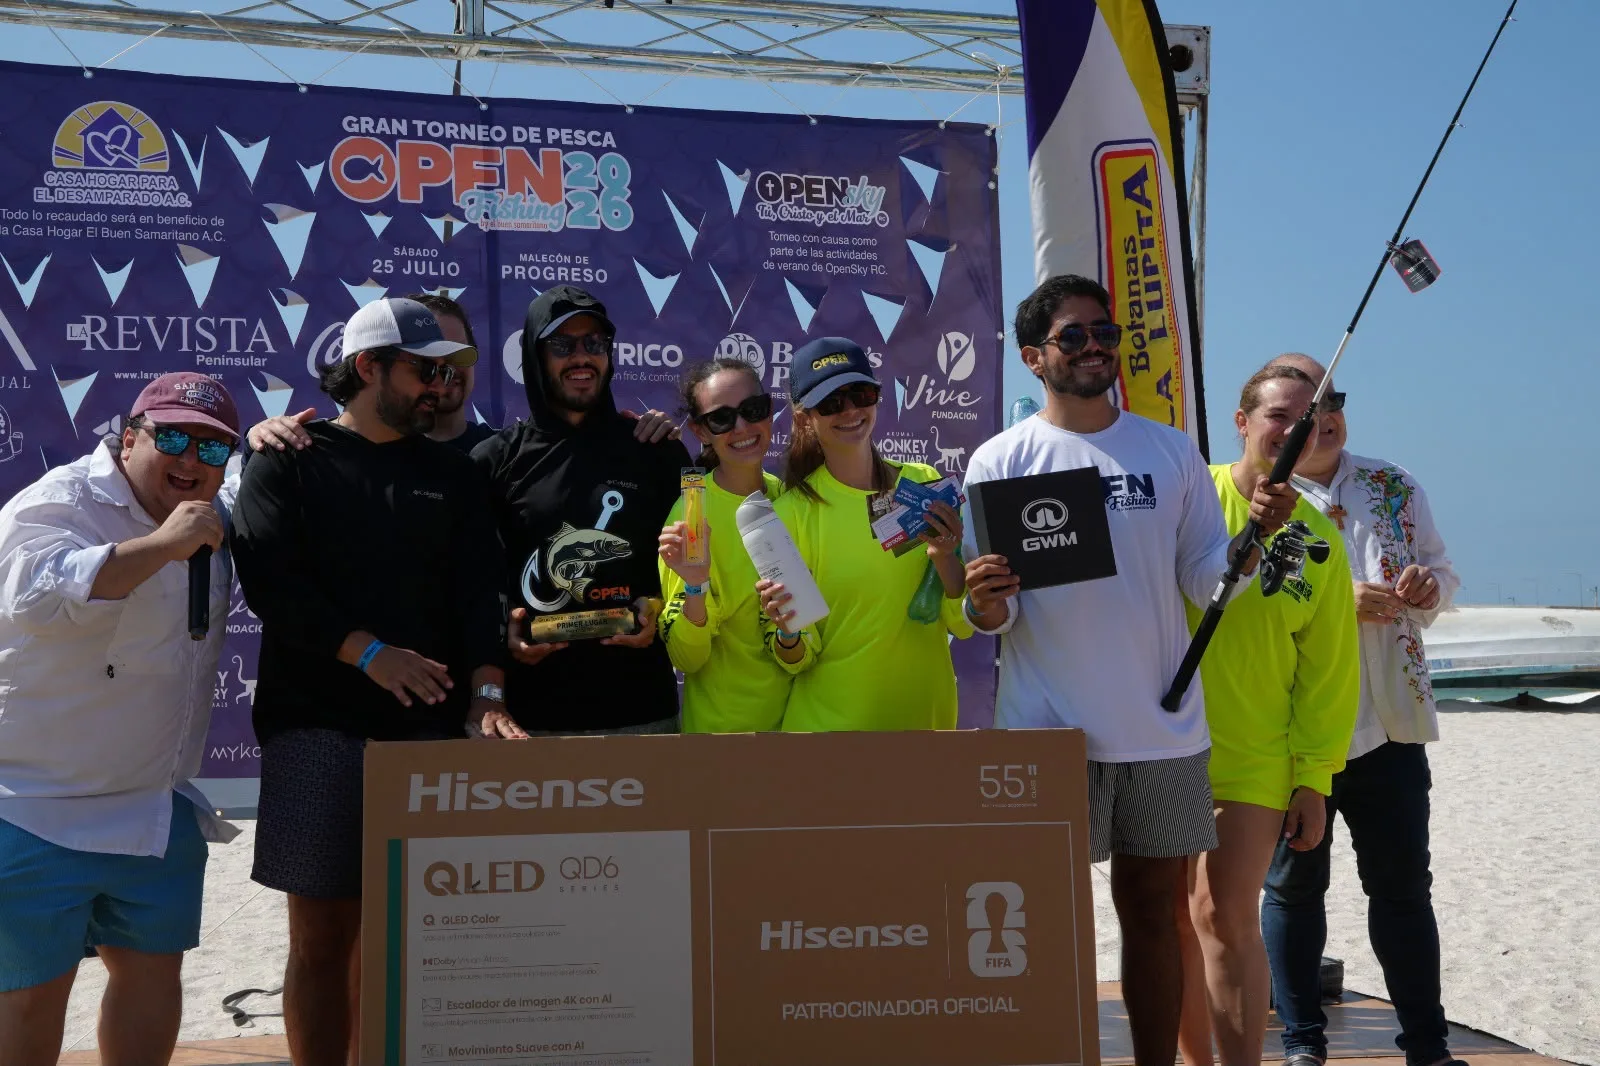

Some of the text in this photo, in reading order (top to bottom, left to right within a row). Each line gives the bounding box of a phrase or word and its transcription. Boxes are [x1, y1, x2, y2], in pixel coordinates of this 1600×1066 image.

[341, 115, 617, 148] GRAN TORNEO DE PESCA
[329, 136, 566, 205] OPEN
[44, 171, 179, 191] CASA HOGAR PARA
[33, 187, 192, 208] EL DESAMPARADO A.C.
[2, 208, 225, 227] Todo lo recaudado será en beneficio de
[460, 189, 567, 231] Fishing
[778, 205, 814, 222] Cristo
[815, 211, 824, 226] y
[826, 208, 839, 223] el
[840, 208, 870, 225] Mar
[0, 225, 226, 242] la Casa Hogar El Buen Samaritano A.C.
[768, 231, 877, 246] Torneo con causa como
[393, 246, 438, 257] SÁBADO
[519, 252, 589, 264] MALECÓN DE
[770, 247, 877, 260] parte de las actividades
[1122, 162, 1168, 342] LUPITA
[372, 259, 460, 276] 25 JULIO
[501, 265, 608, 283] PROGRESO
[763, 260, 888, 277] de verano de OpenSky RC.
[1124, 234, 1150, 377] Botanas
[69, 325, 88, 338] LA
[81, 315, 278, 353] REVISTA
[196, 354, 267, 367] Peninsular
[812, 353, 850, 371] OPEN
[639, 371, 647, 381] &
[649, 372, 680, 382] confort
[174, 382, 224, 402] SAN DIEGO
[904, 374, 981, 410] Vive
[180, 396, 218, 411] CALIFORNIA
[931, 410, 978, 420] FUNDACIÓN
[873, 440, 928, 454] MONKEY
[1100, 474, 1155, 497] EN
[1106, 493, 1157, 510] Fishing
[1022, 531, 1078, 552] GWM
[590, 585, 631, 600] OPEN
[556, 618, 608, 630] PRIMER LUGAR
[408, 772, 644, 812] Hisense
[424, 855, 619, 896] QLED QD6
[559, 884, 619, 893] SERIES
[441, 915, 469, 926] QLED
[470, 914, 500, 925] Color
[760, 921, 928, 950] Hisense
[433, 957, 456, 967] Dolby
[985, 957, 1012, 968] FIFA
[447, 999, 500, 1010] Escalador
[503, 998, 517, 1008] de
[563, 995, 577, 1005] 4K
[579, 996, 598, 1005] con
[601, 994, 612, 1004] AI
[782, 996, 1020, 1021] PATROCINADOR OFICIAL
[448, 1041, 584, 1057] Movimiento Suave con AI
